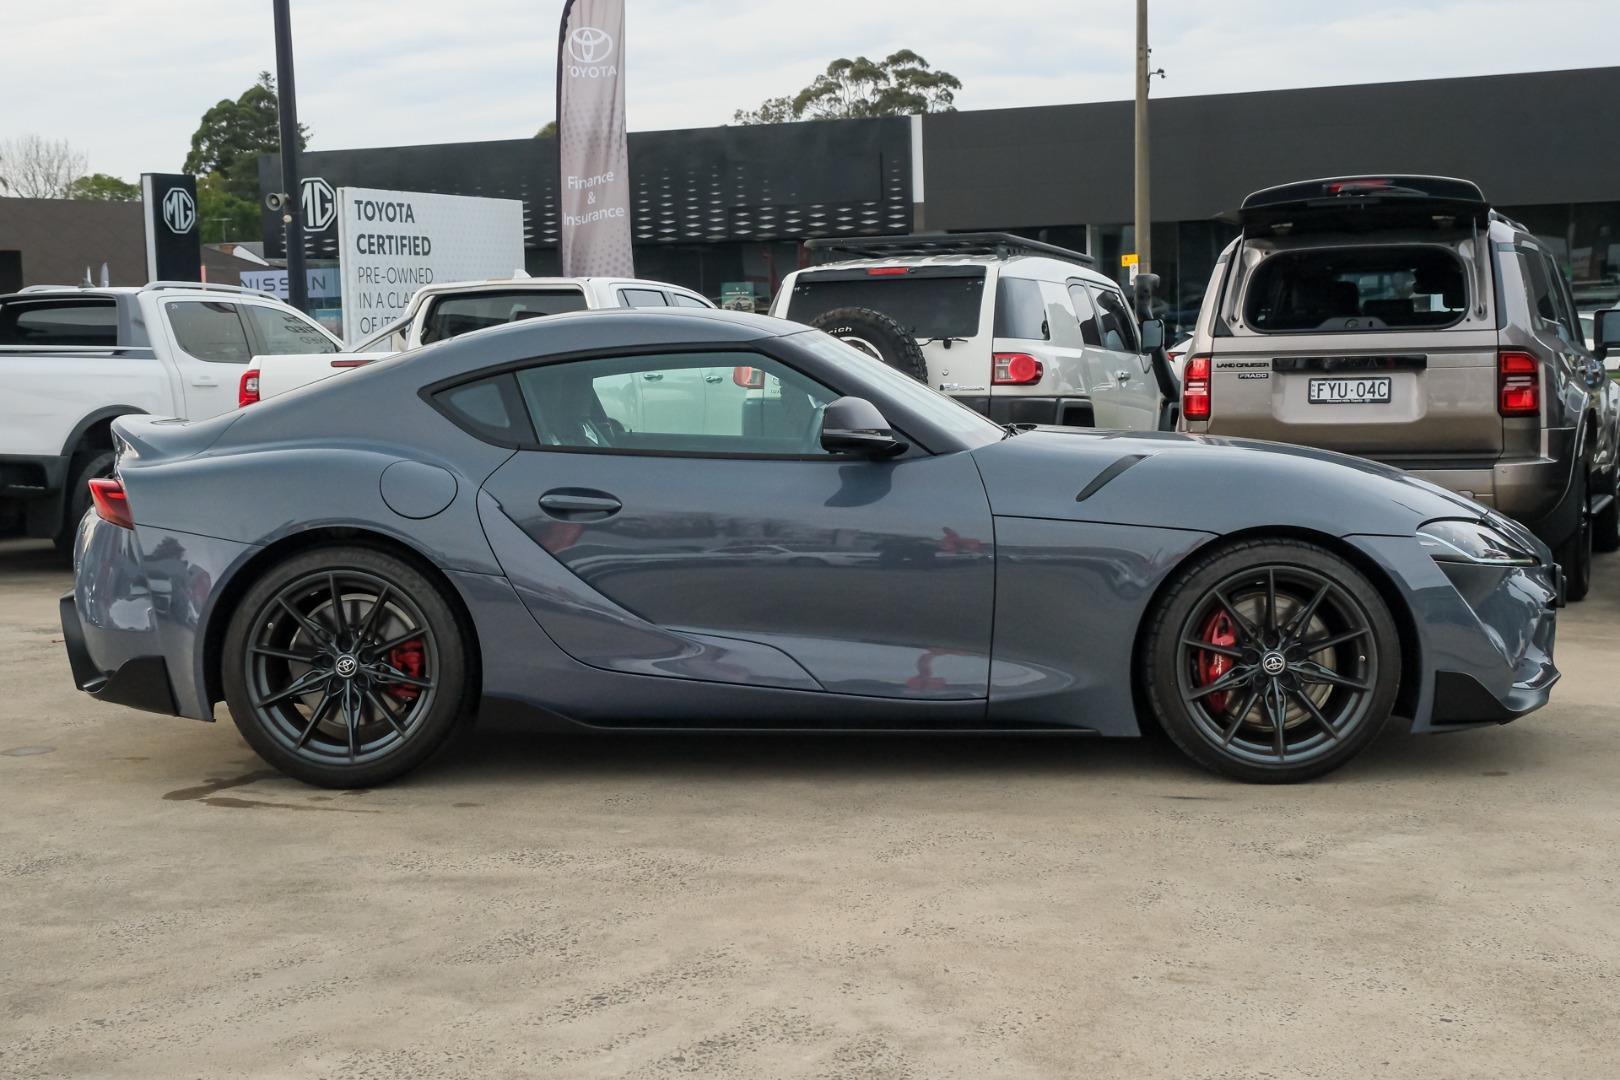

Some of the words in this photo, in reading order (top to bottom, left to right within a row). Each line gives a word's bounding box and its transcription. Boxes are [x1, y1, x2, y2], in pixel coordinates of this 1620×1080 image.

[567, 65, 617, 78] OYOTA
[567, 170, 615, 190] Finance
[587, 191, 596, 205] &
[354, 200, 415, 223] TOYOTA
[563, 206, 625, 226] Insurance
[356, 233, 432, 256] CERTIFIED
[240, 277, 326, 291] NISSN
[358, 266, 434, 285] PRE-OWNED
[359, 292, 372, 309] IN
[376, 292, 385, 308] A
[387, 291, 416, 309] CLA
[360, 316, 377, 334] OF
